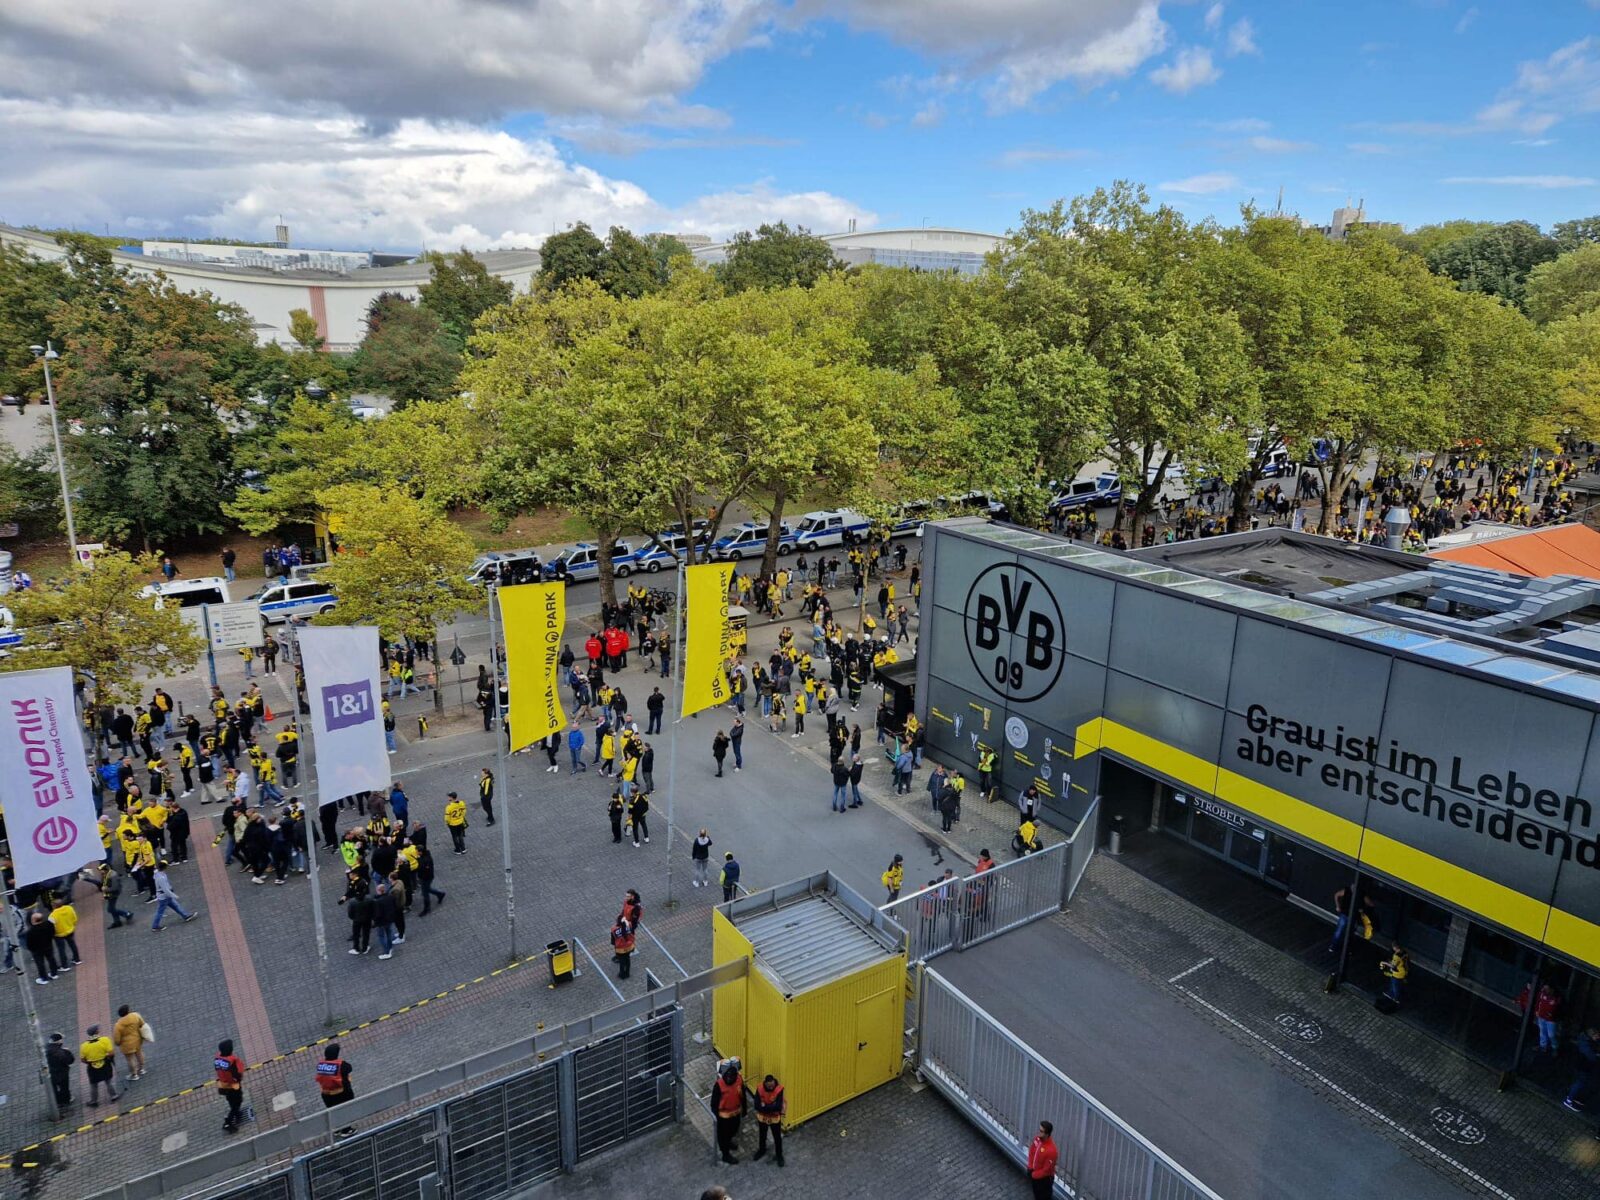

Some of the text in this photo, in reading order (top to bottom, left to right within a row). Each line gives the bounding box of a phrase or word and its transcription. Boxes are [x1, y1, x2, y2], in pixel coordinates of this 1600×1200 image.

[545, 592, 559, 629] PARK
[976, 573, 1055, 671] BVB
[995, 656, 1023, 690] 09
[328, 690, 368, 718] 1&1
[11, 698, 60, 808] EVONIK
[45, 697, 74, 800] Leading Beyond Chemistry
[1237, 736, 1313, 777] aber
[1246, 704, 1592, 828] Grau ist im Leben
[1193, 796, 1245, 827] STROBELS
